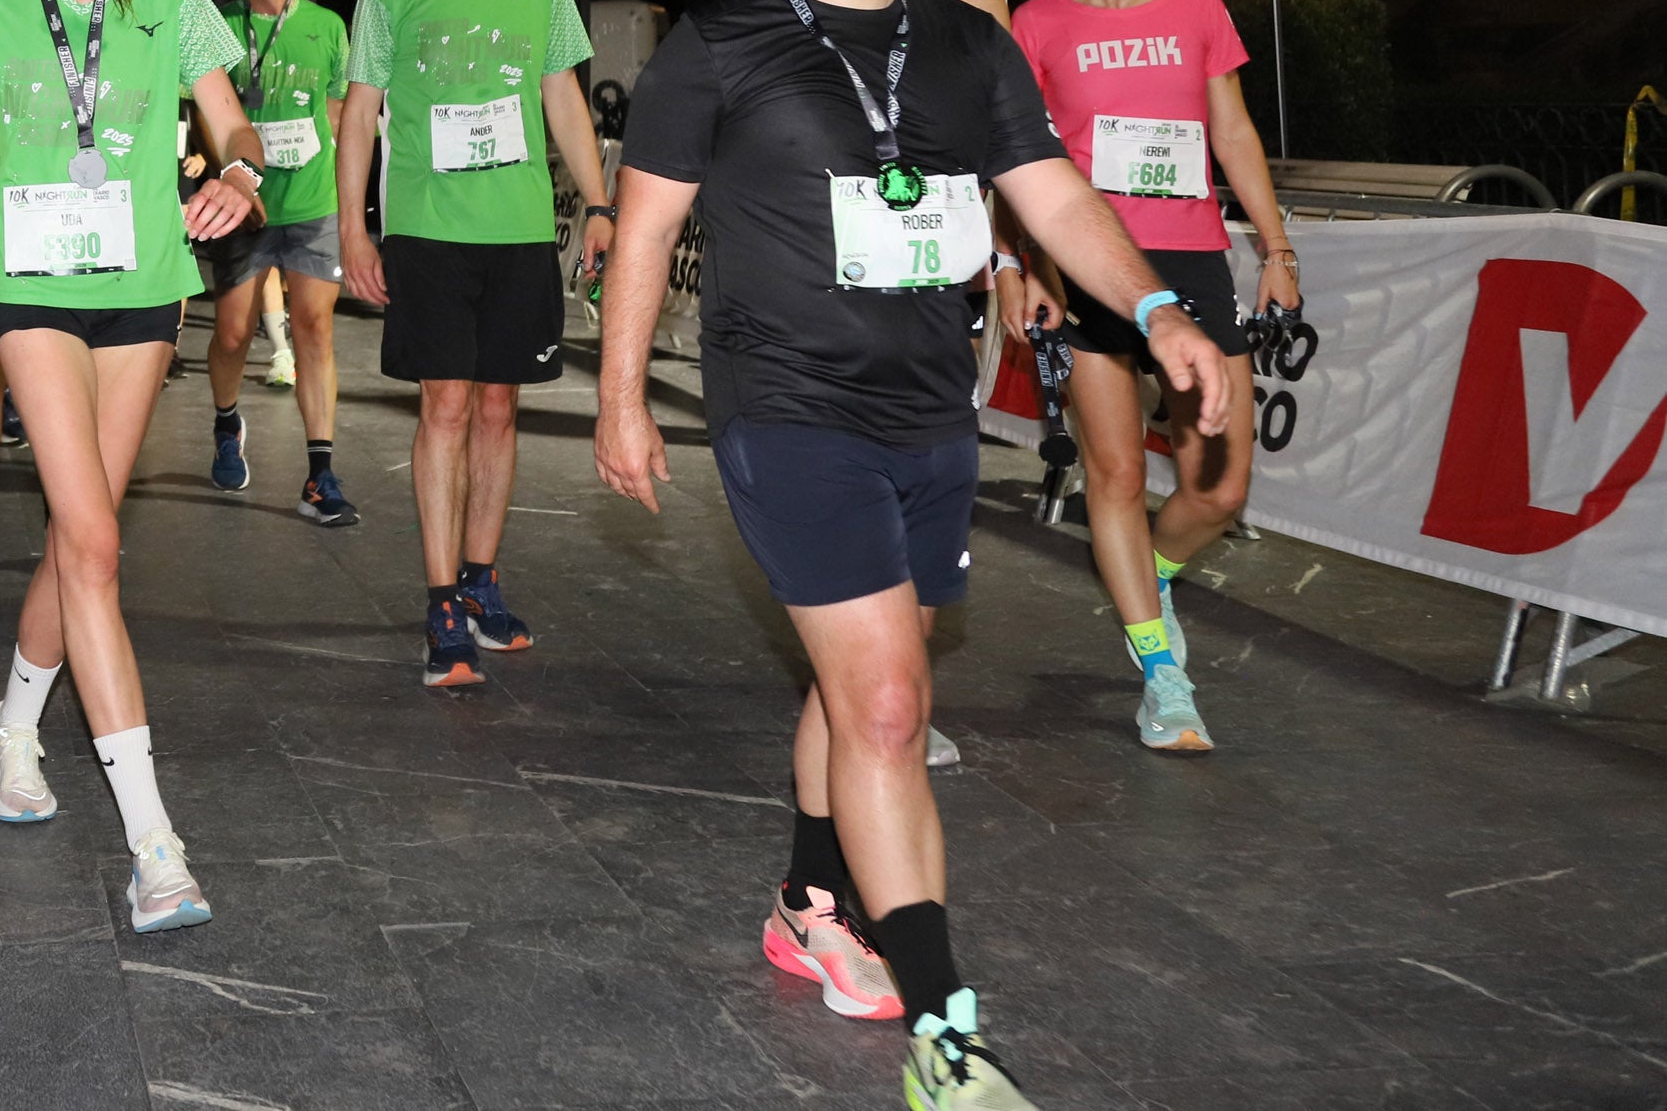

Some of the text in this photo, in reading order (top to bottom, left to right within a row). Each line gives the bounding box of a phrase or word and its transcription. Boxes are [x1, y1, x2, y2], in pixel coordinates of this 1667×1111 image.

[58, 46, 81, 88] FINISHER
[499, 64, 524, 77] 2025
[434, 106, 451, 120] 10K
[511, 101, 518, 113] 3
[101, 128, 135, 147] 2025
[470, 124, 494, 137] ANDER
[1098, 118, 1120, 133] 10K
[1195, 129, 1202, 142] 2
[276, 148, 300, 165] 318
[467, 137, 497, 162] 767
[1127, 161, 1177, 187] F684
[8, 187, 30, 205] 10K
[120, 188, 128, 203] 3
[837, 179, 867, 201] 10K
[964, 185, 976, 203] 2
[901, 213, 944, 230] ROBER
[907, 238, 942, 275] 78
